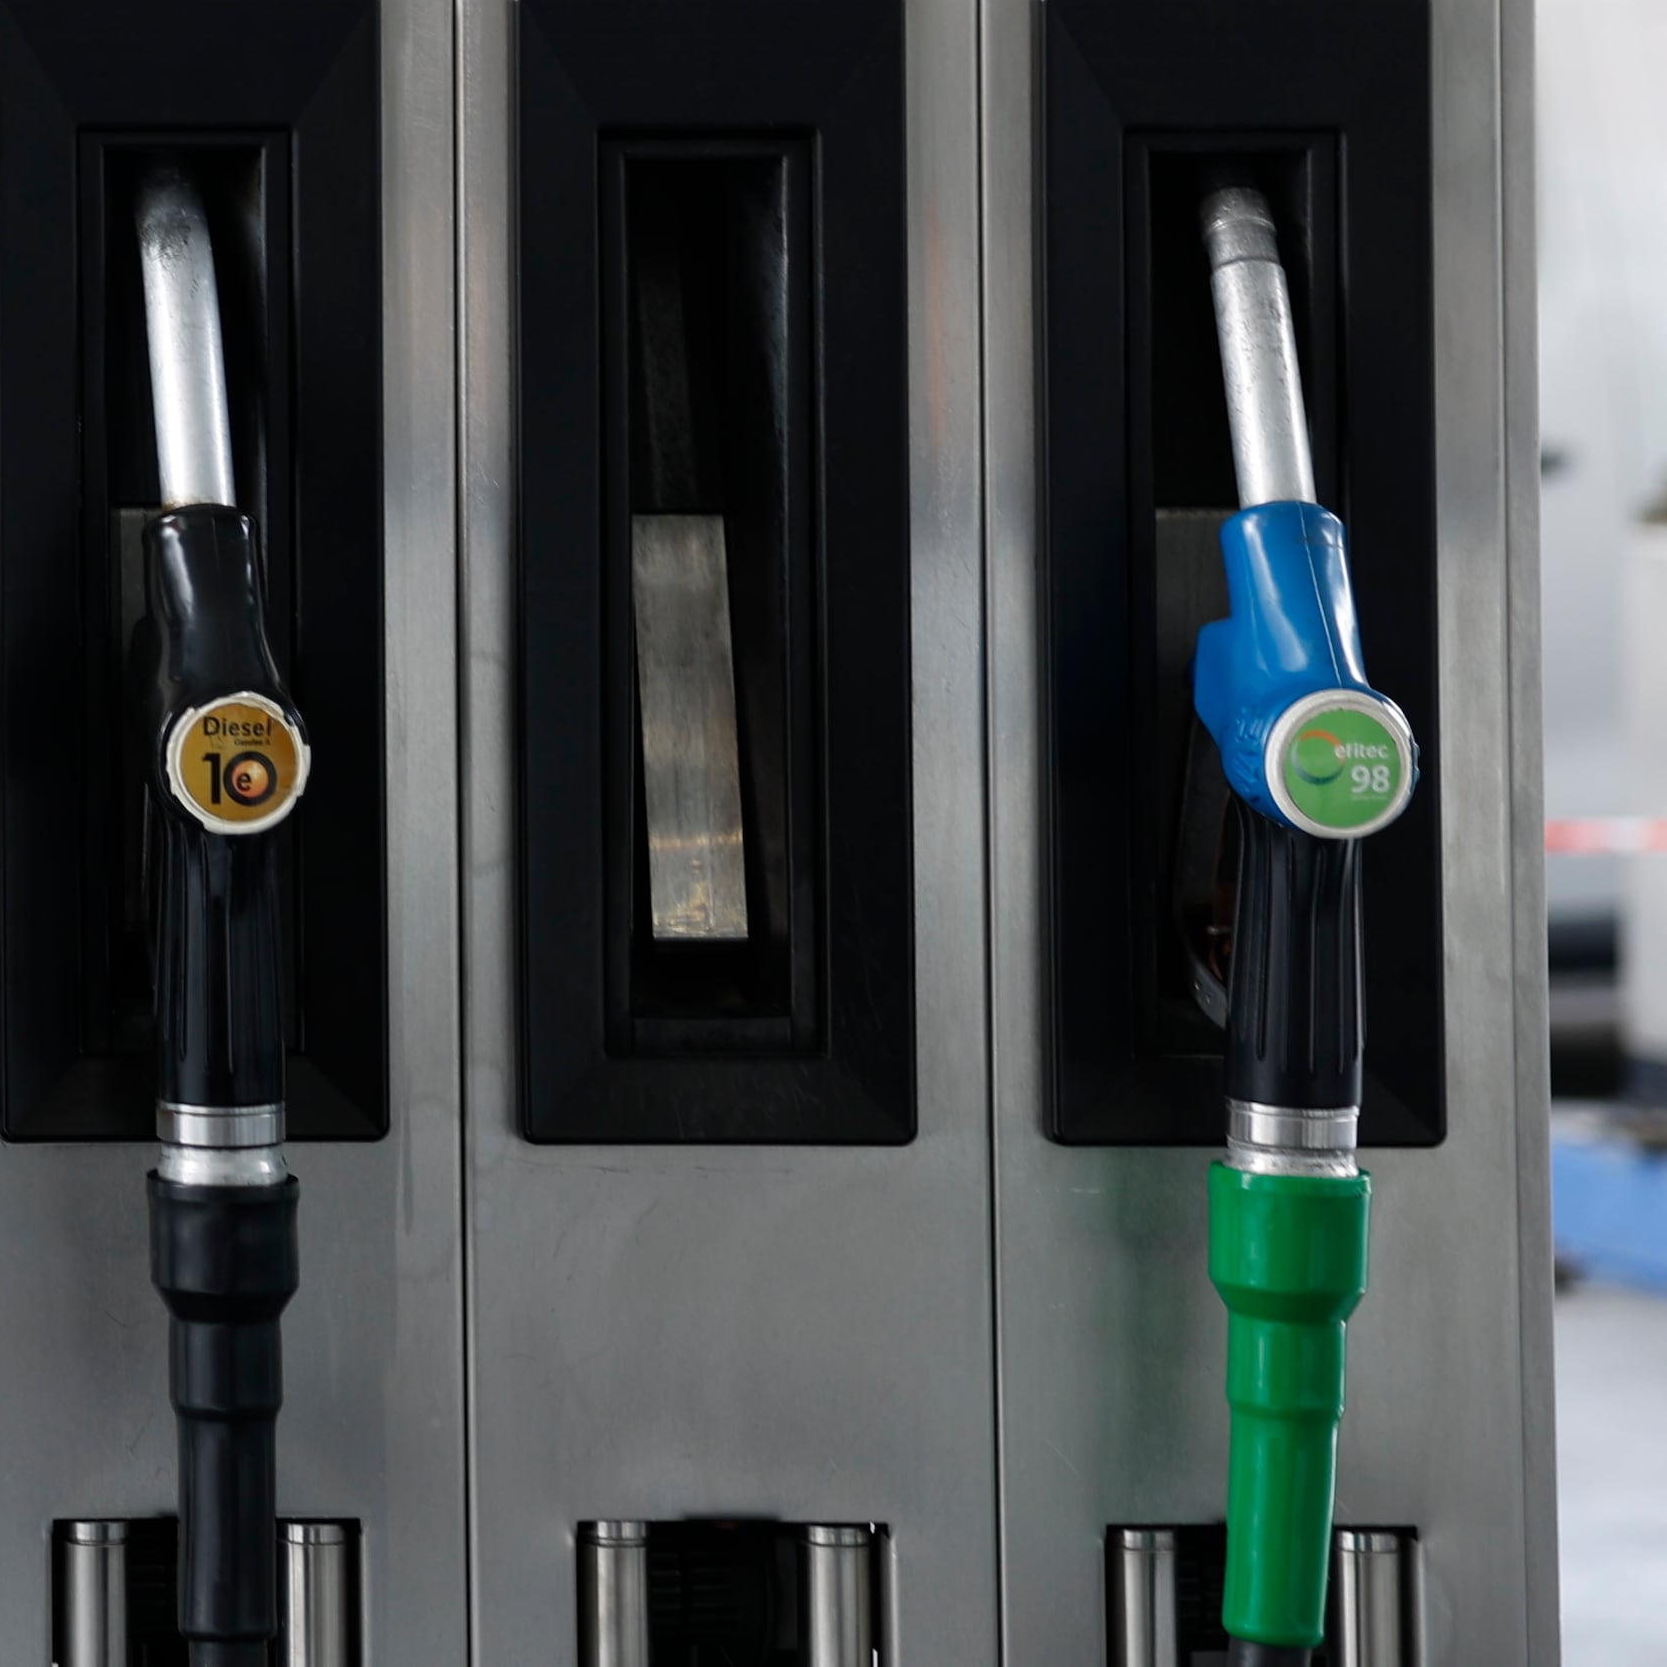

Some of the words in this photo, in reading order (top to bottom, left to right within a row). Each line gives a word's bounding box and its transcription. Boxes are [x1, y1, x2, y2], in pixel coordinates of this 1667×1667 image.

[204, 716, 271, 736] Diesel
[1335, 742, 1389, 759] efitec
[203, 751, 276, 806] 10
[1351, 765, 1389, 793] 98
